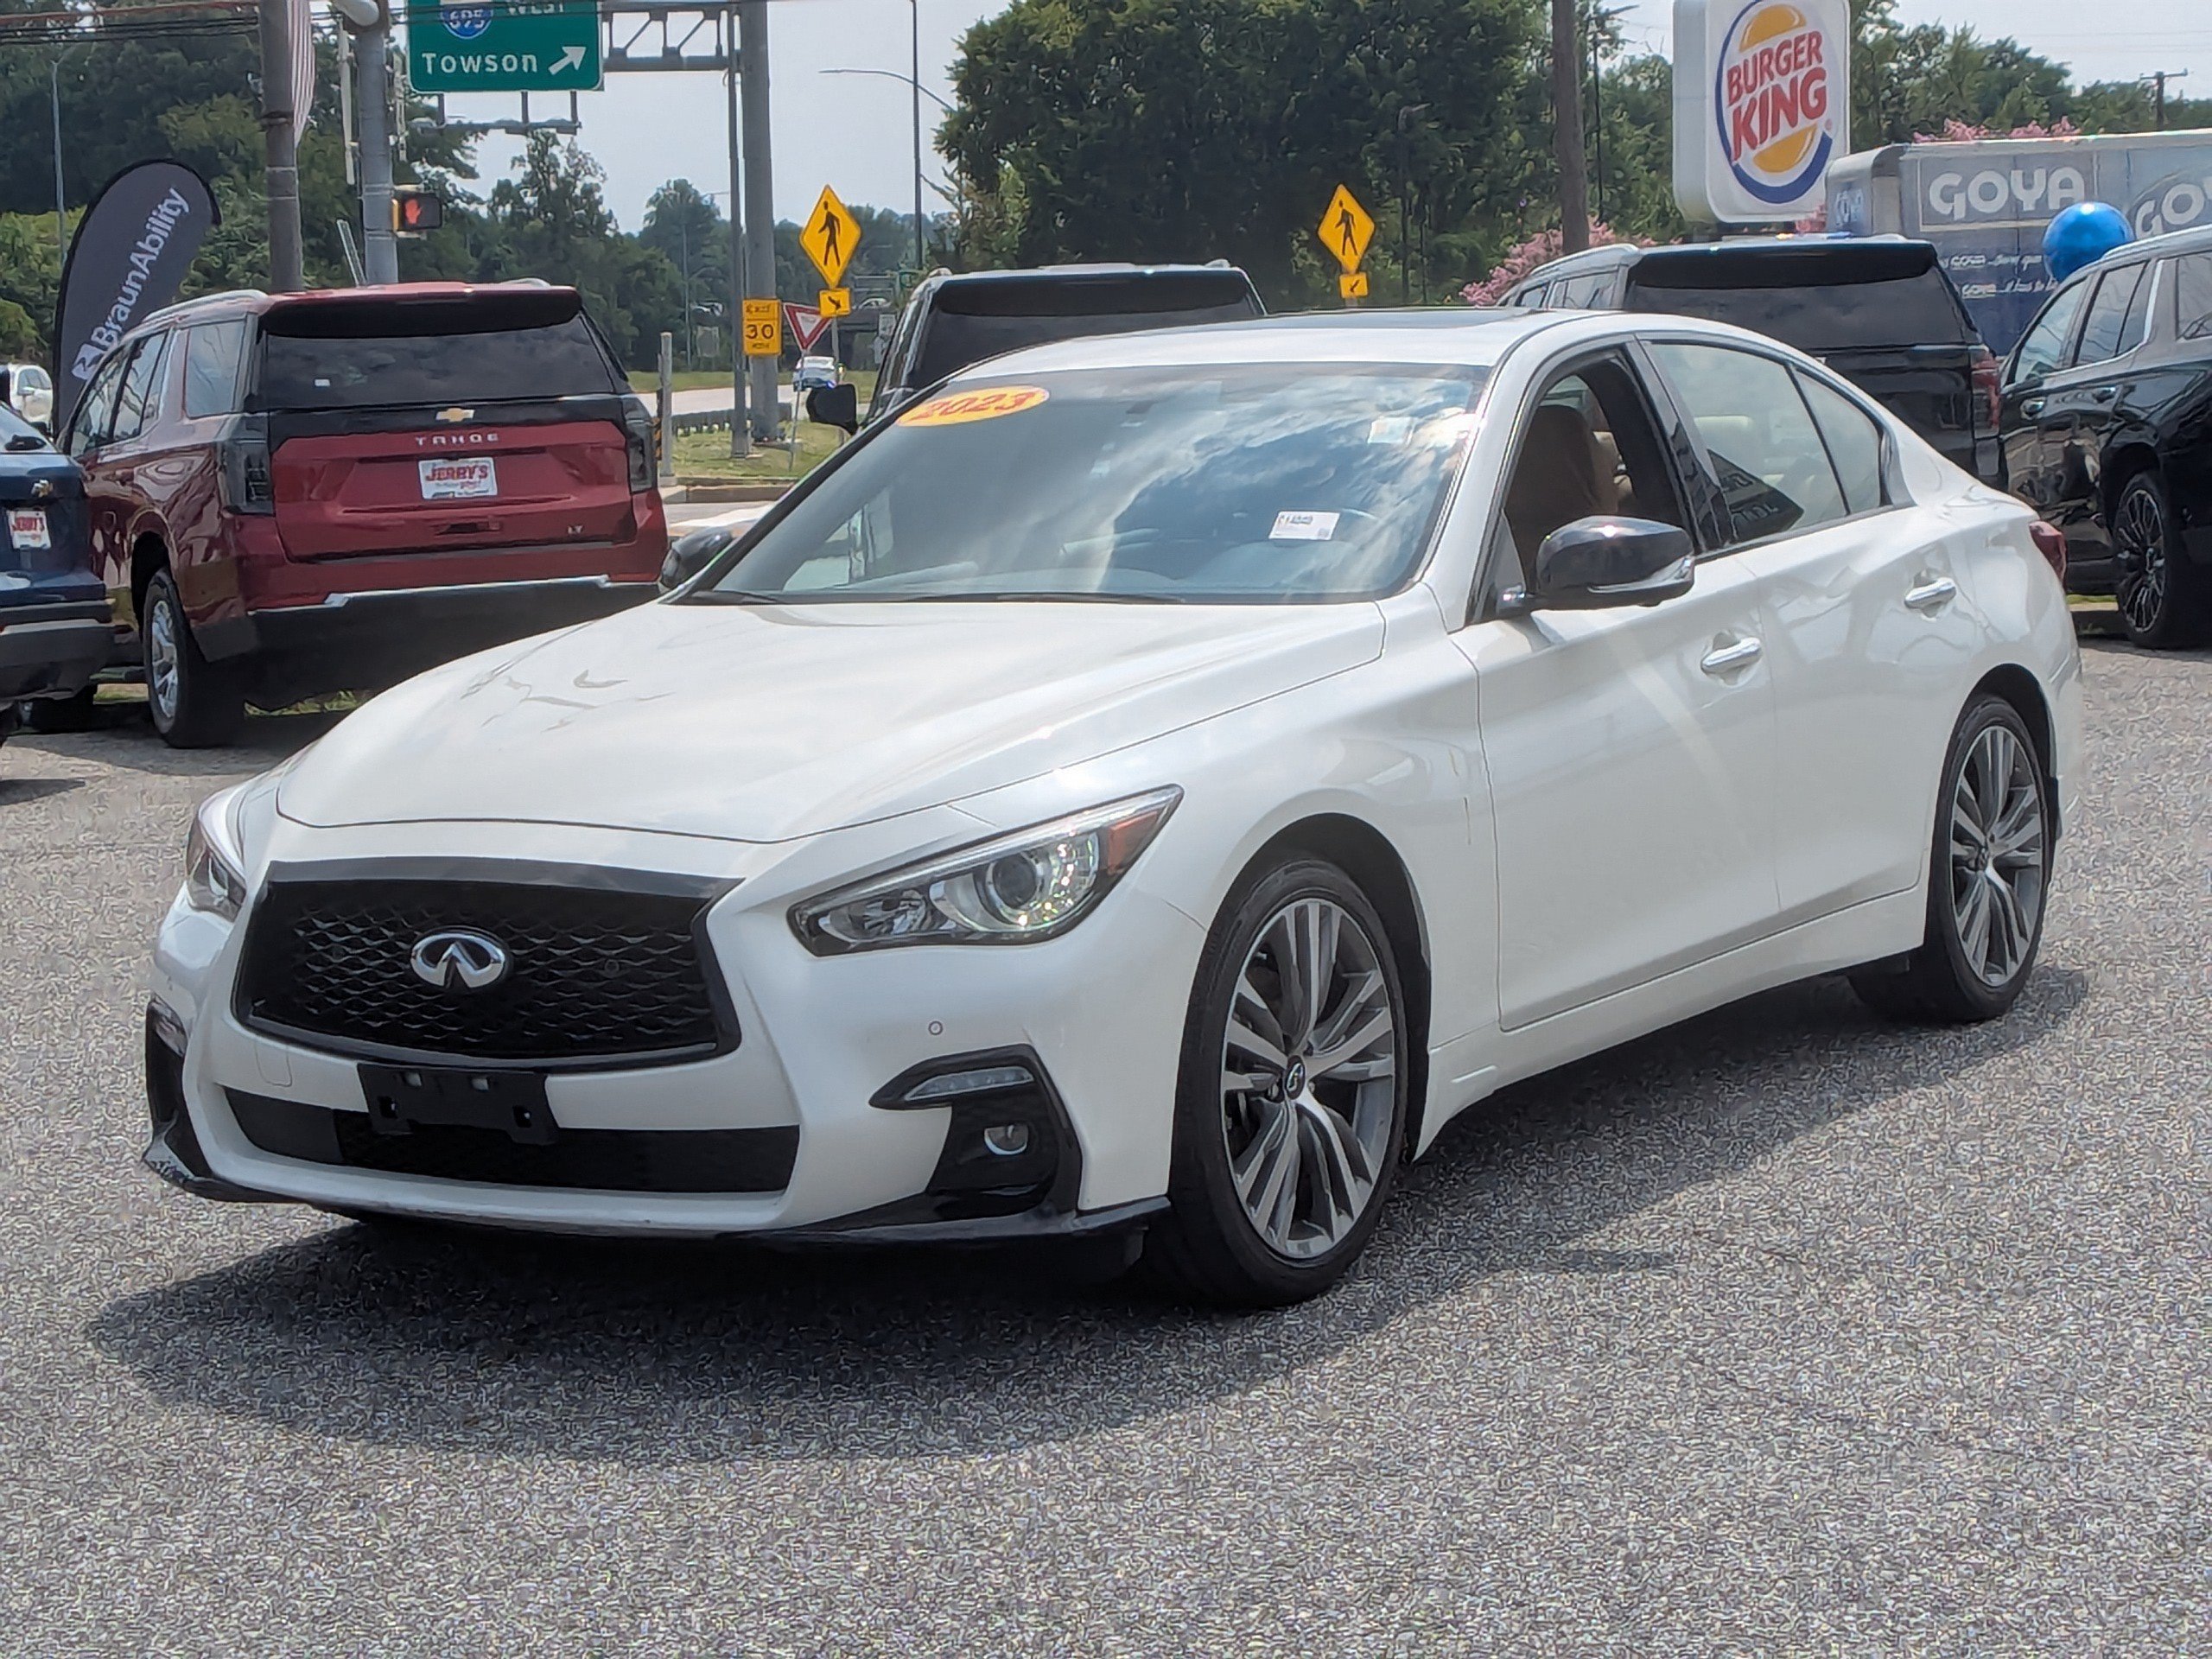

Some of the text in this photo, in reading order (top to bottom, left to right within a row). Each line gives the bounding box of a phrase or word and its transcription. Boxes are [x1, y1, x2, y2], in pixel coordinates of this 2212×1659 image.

[422, 53, 537, 74] Towson
[1726, 30, 1823, 109] BURGER
[1732, 67, 1827, 162] KING
[1929, 167, 2085, 220] GOYA
[90, 187, 190, 348] BraunAbility
[746, 324, 774, 340] 30
[909, 391, 1036, 421] 2023
[415, 433, 499, 446] TAHOE
